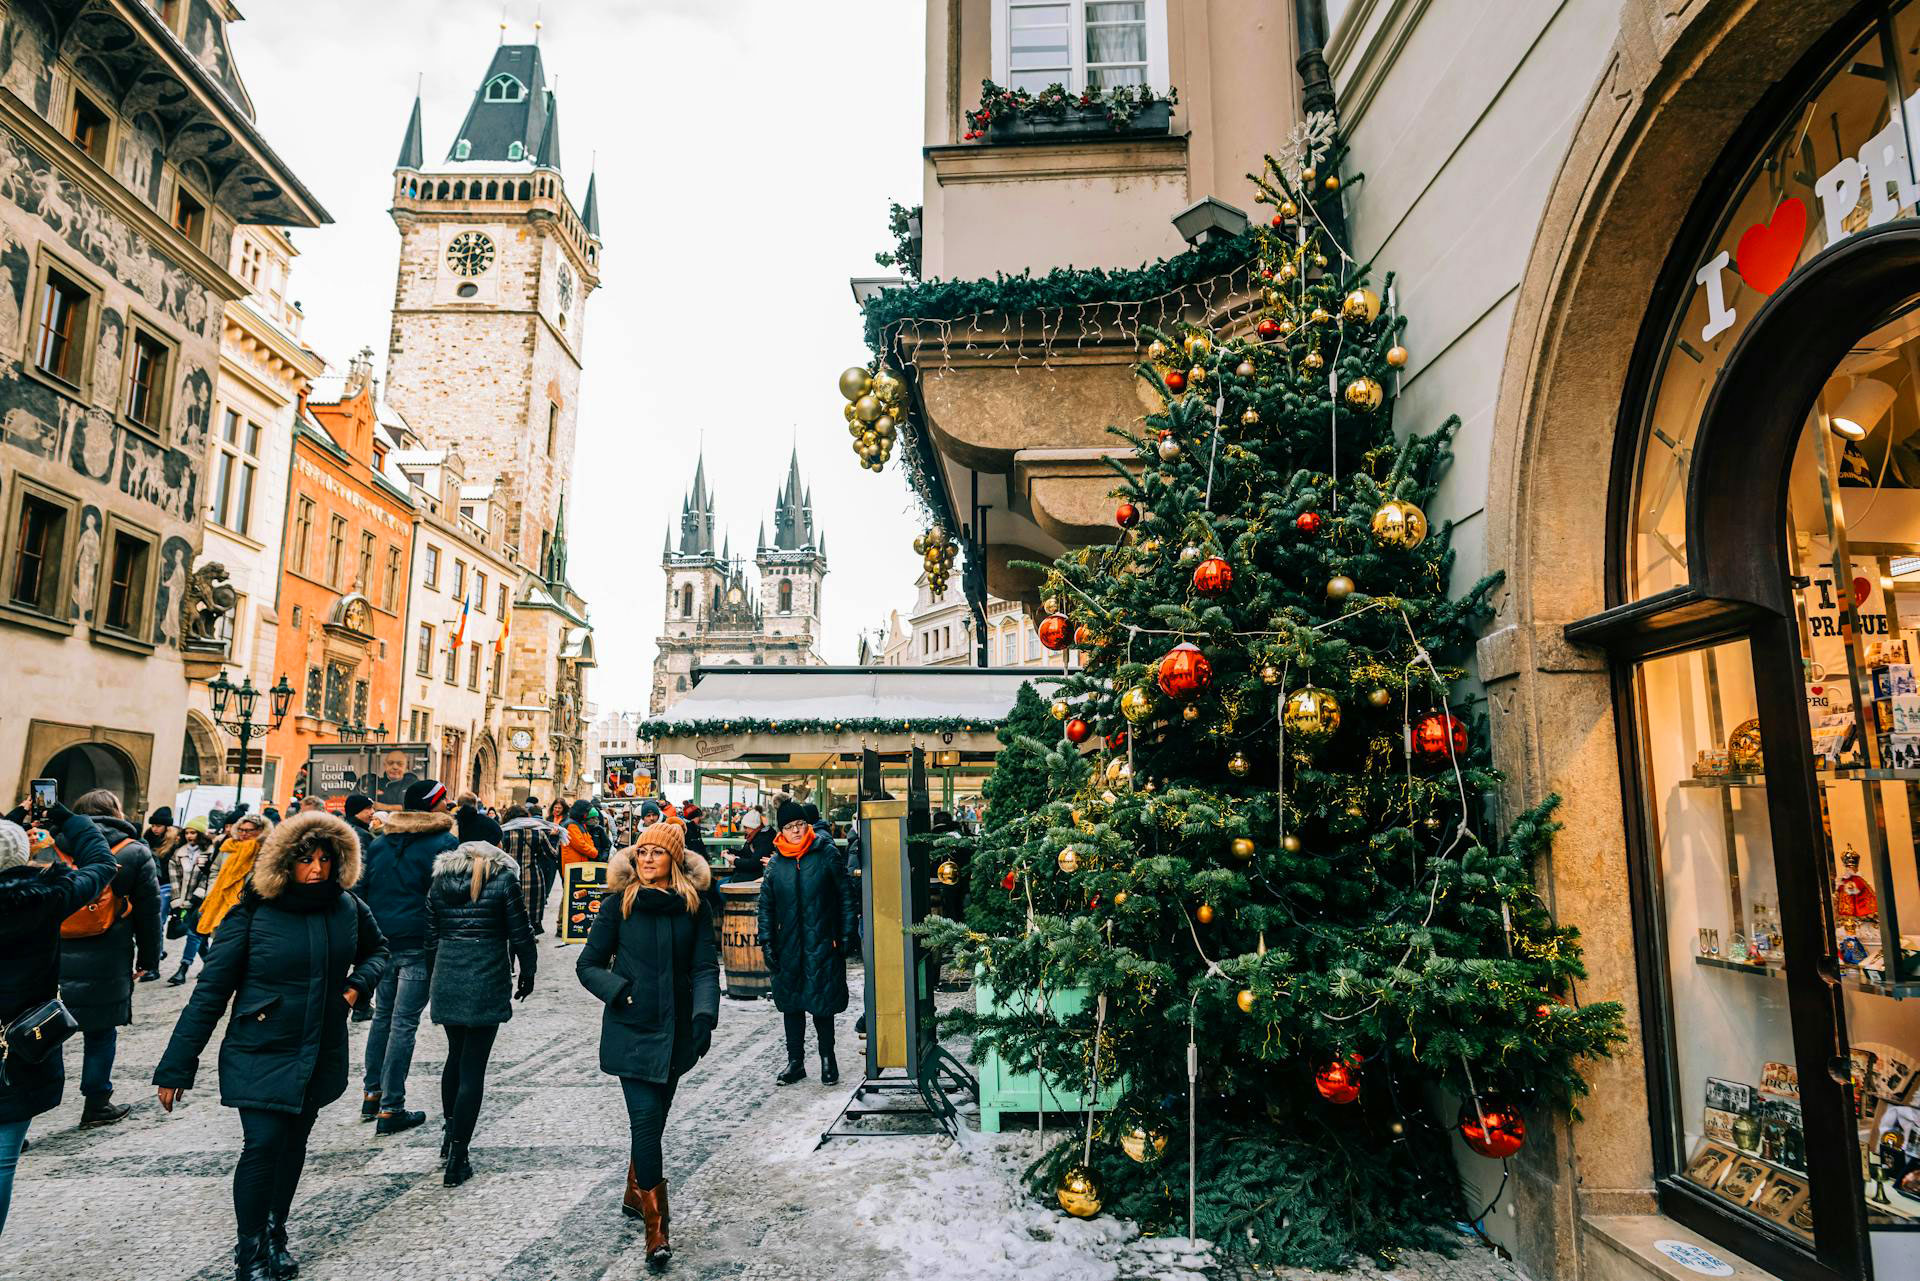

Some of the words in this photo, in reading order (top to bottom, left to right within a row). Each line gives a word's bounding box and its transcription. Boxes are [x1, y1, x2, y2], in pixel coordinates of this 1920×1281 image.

[1696, 250, 1736, 342] I
[1812, 579, 1836, 609] I
[1808, 614, 1889, 637] PRUE
[321, 771, 344, 780] food
[322, 763, 354, 772] Italian
[321, 780, 357, 791] quality
